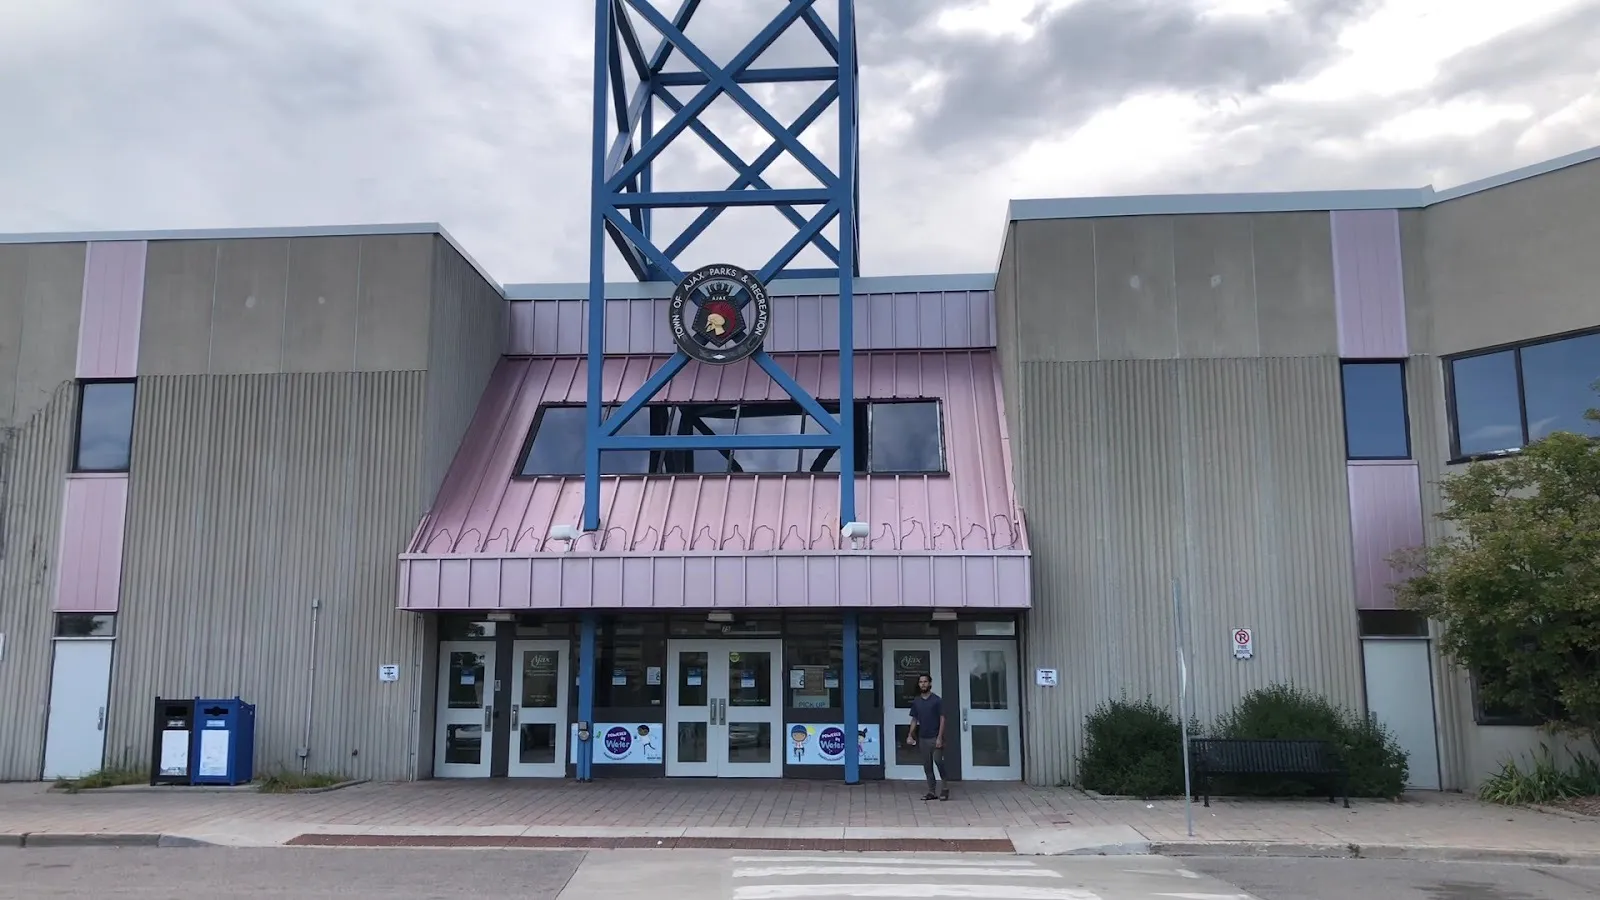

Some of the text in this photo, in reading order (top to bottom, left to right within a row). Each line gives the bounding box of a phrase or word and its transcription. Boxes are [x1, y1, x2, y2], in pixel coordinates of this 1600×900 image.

[672, 267, 767, 339] TOWN OF AJAX PARKS & RECREATION
[816, 700, 826, 708] UP
[606, 739, 630, 748] Water
[820, 740, 845, 749] Water
